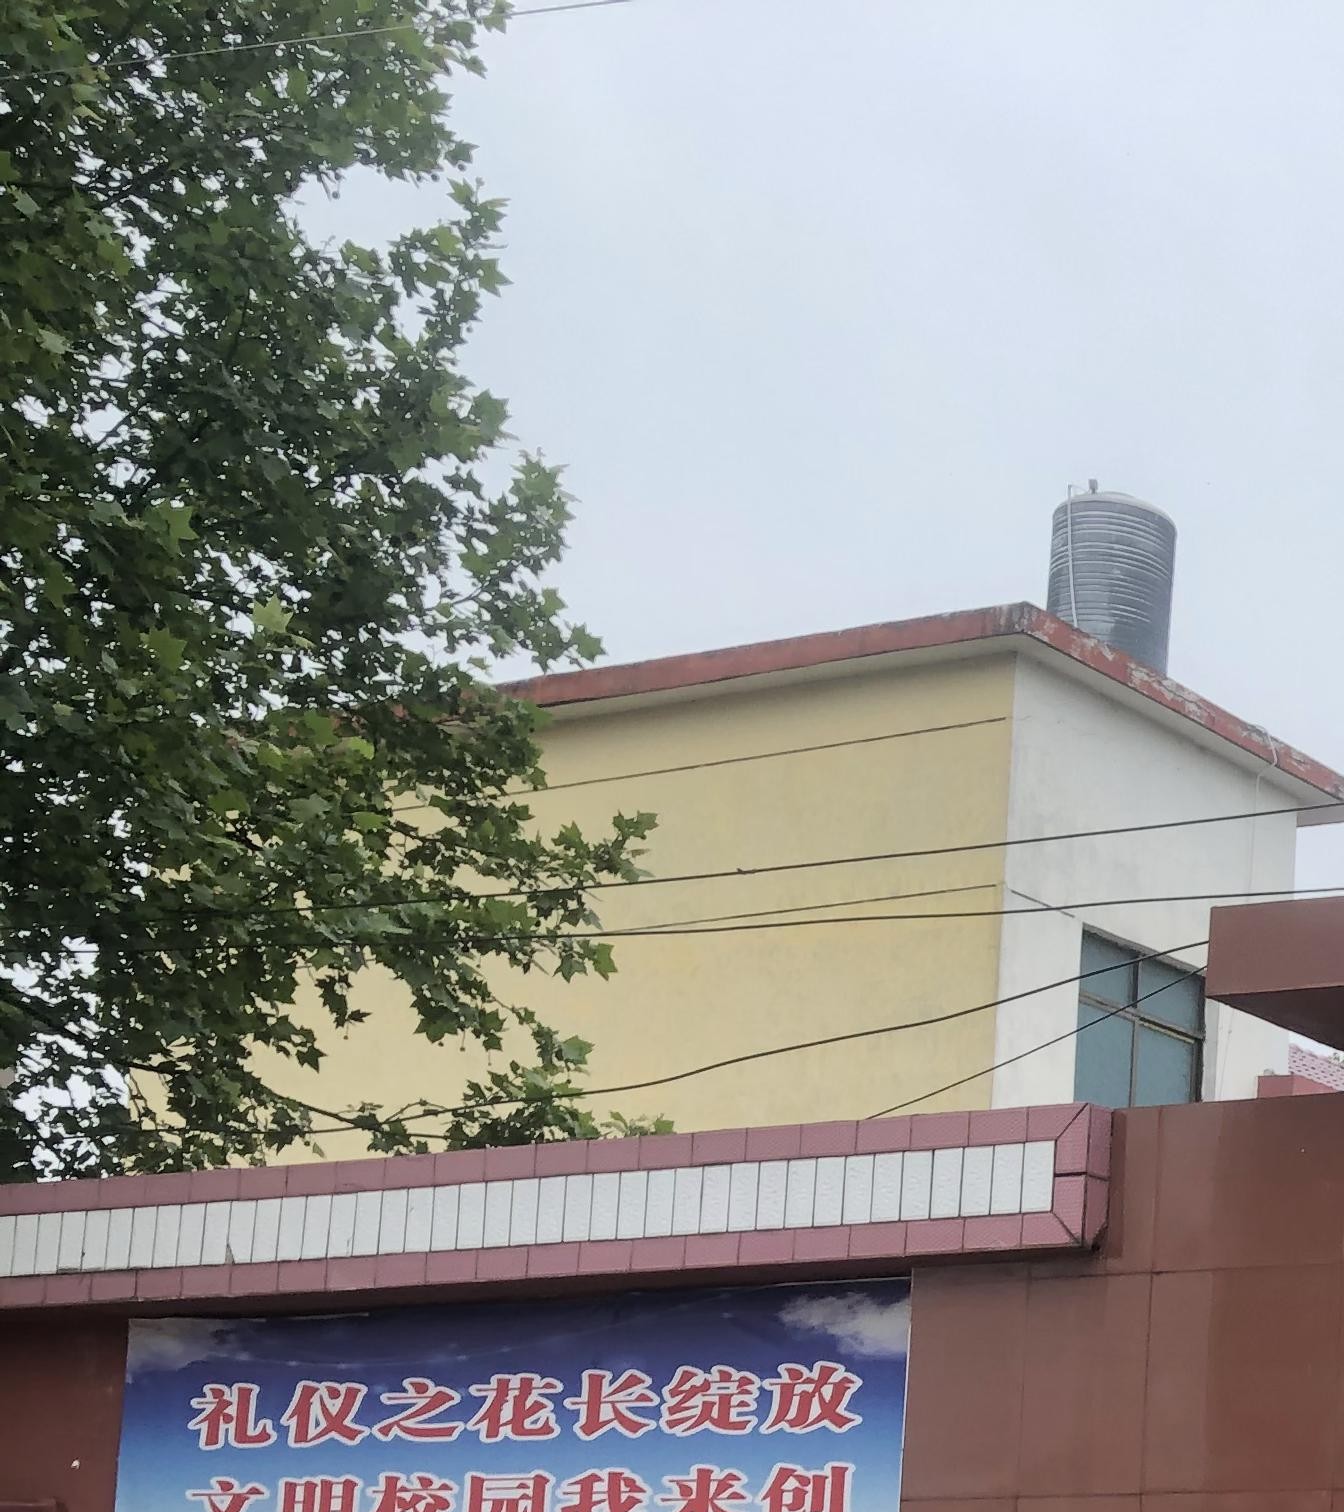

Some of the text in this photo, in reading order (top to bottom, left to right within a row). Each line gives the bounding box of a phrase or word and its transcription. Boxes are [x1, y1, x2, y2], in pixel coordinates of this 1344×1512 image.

[190, 1362, 862, 1450] 礼仪之花长绽放
